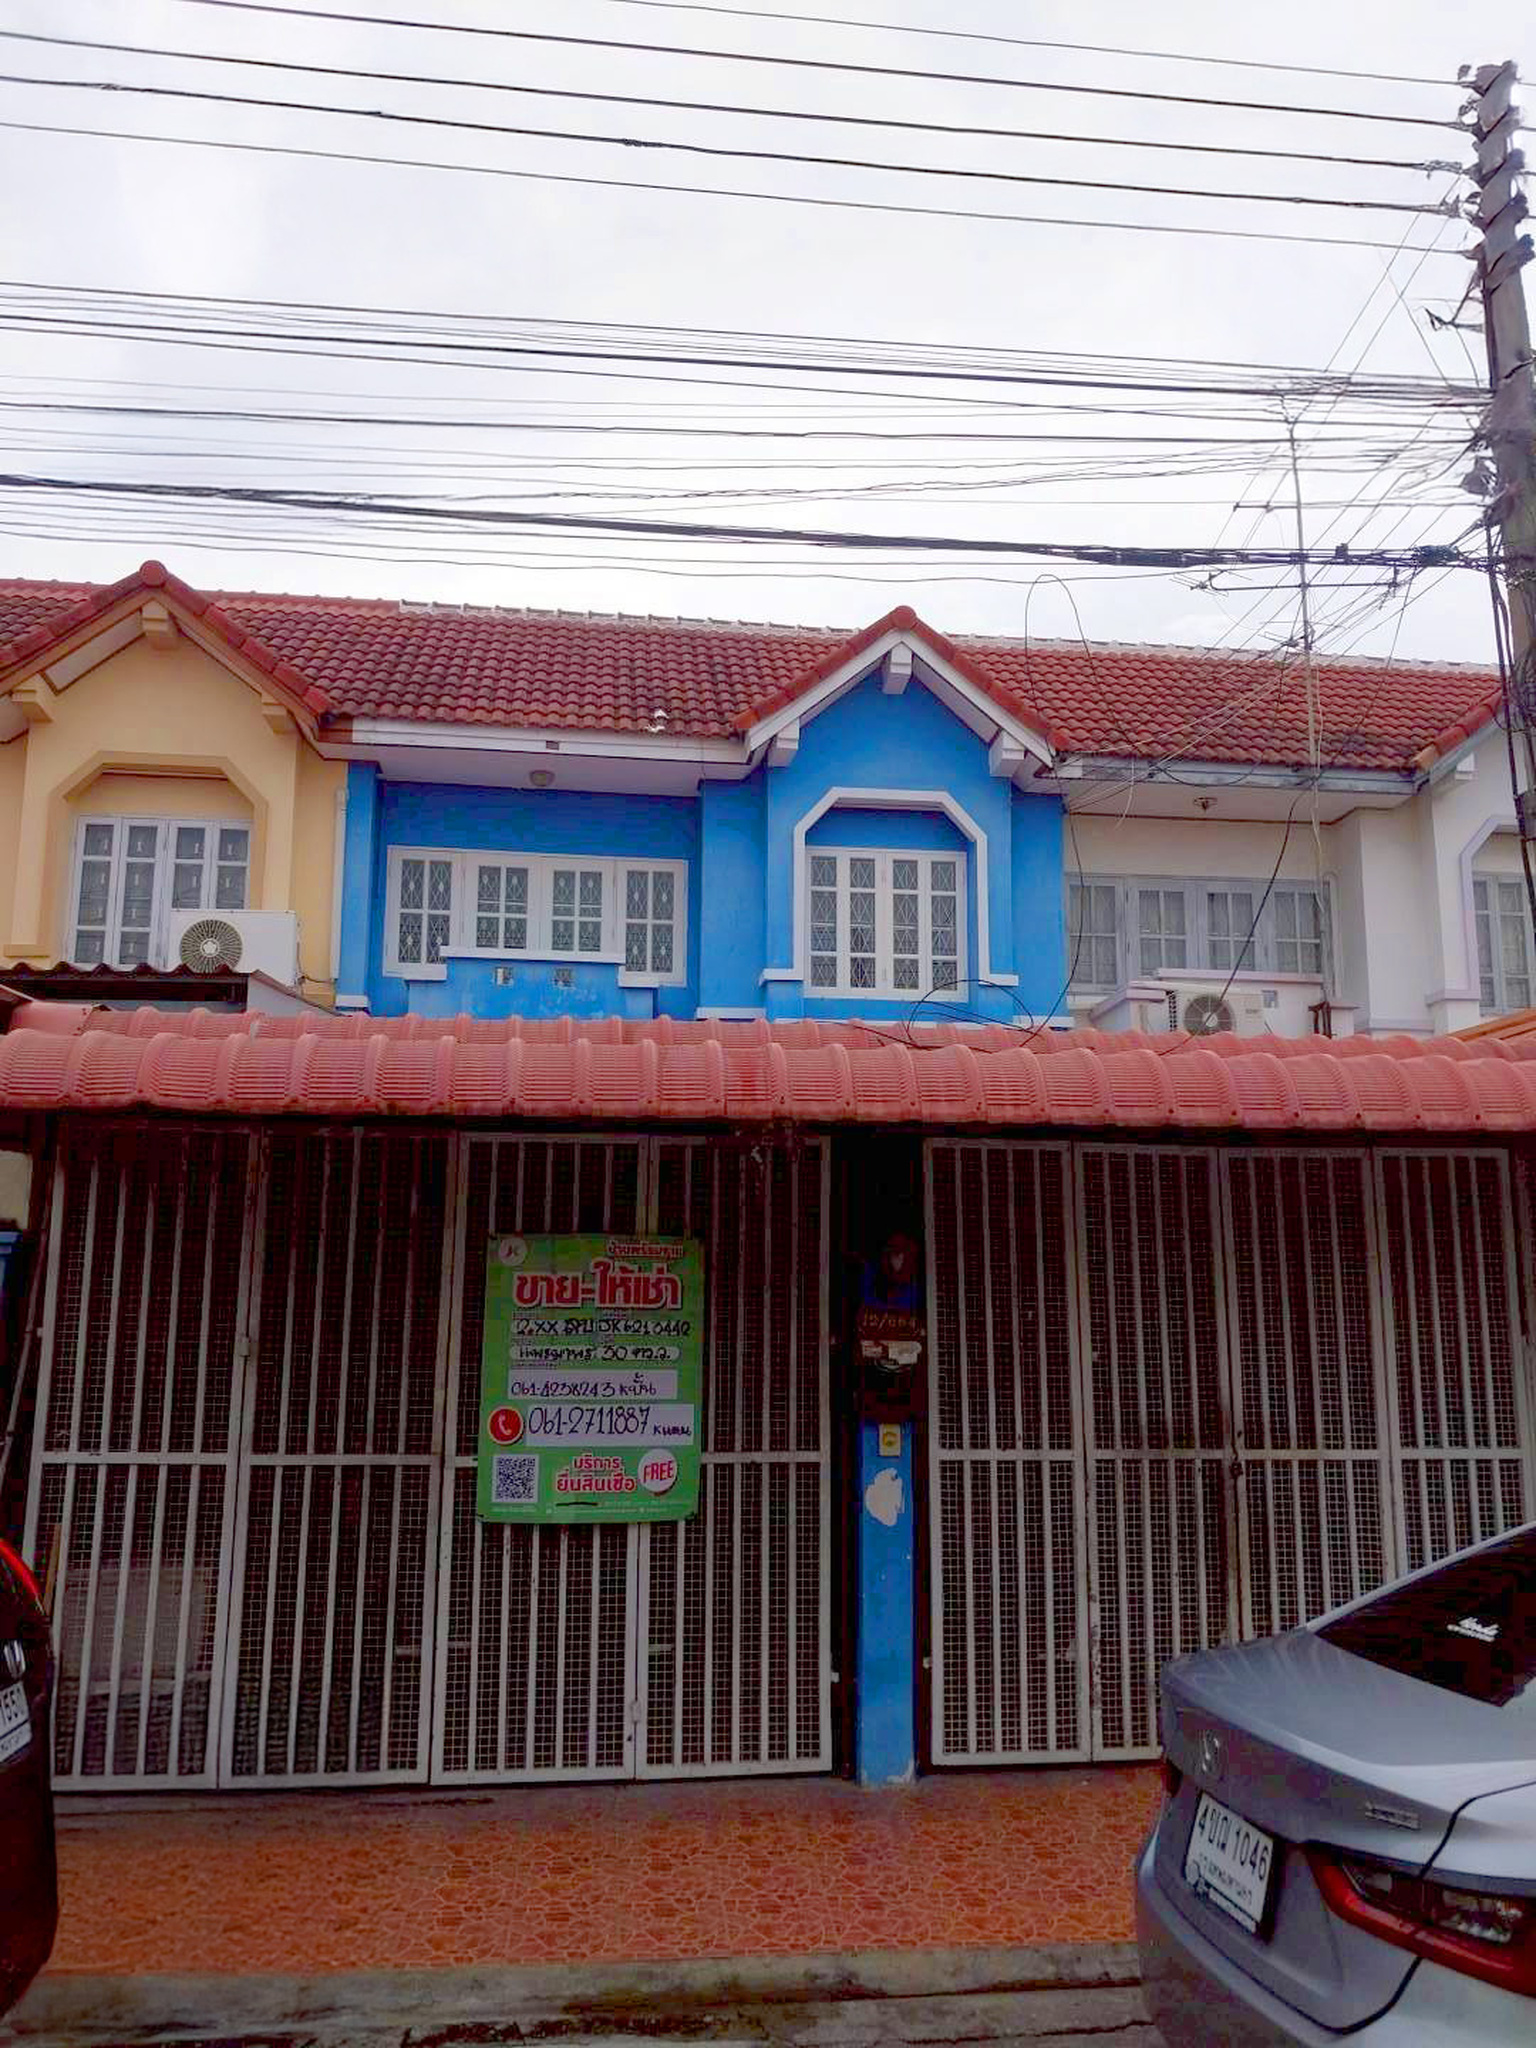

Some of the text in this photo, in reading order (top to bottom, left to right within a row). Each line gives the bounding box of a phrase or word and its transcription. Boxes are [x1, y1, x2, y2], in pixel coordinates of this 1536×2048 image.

[514, 1258, 682, 1307] ขาย-ให้เช่า
[528, 1405, 652, 1436] 061-2711887
[573, 1451, 621, 1470] บริการ
[643, 1460, 674, 1484] FREE
[1232, 1827, 1270, 1882] 1046
